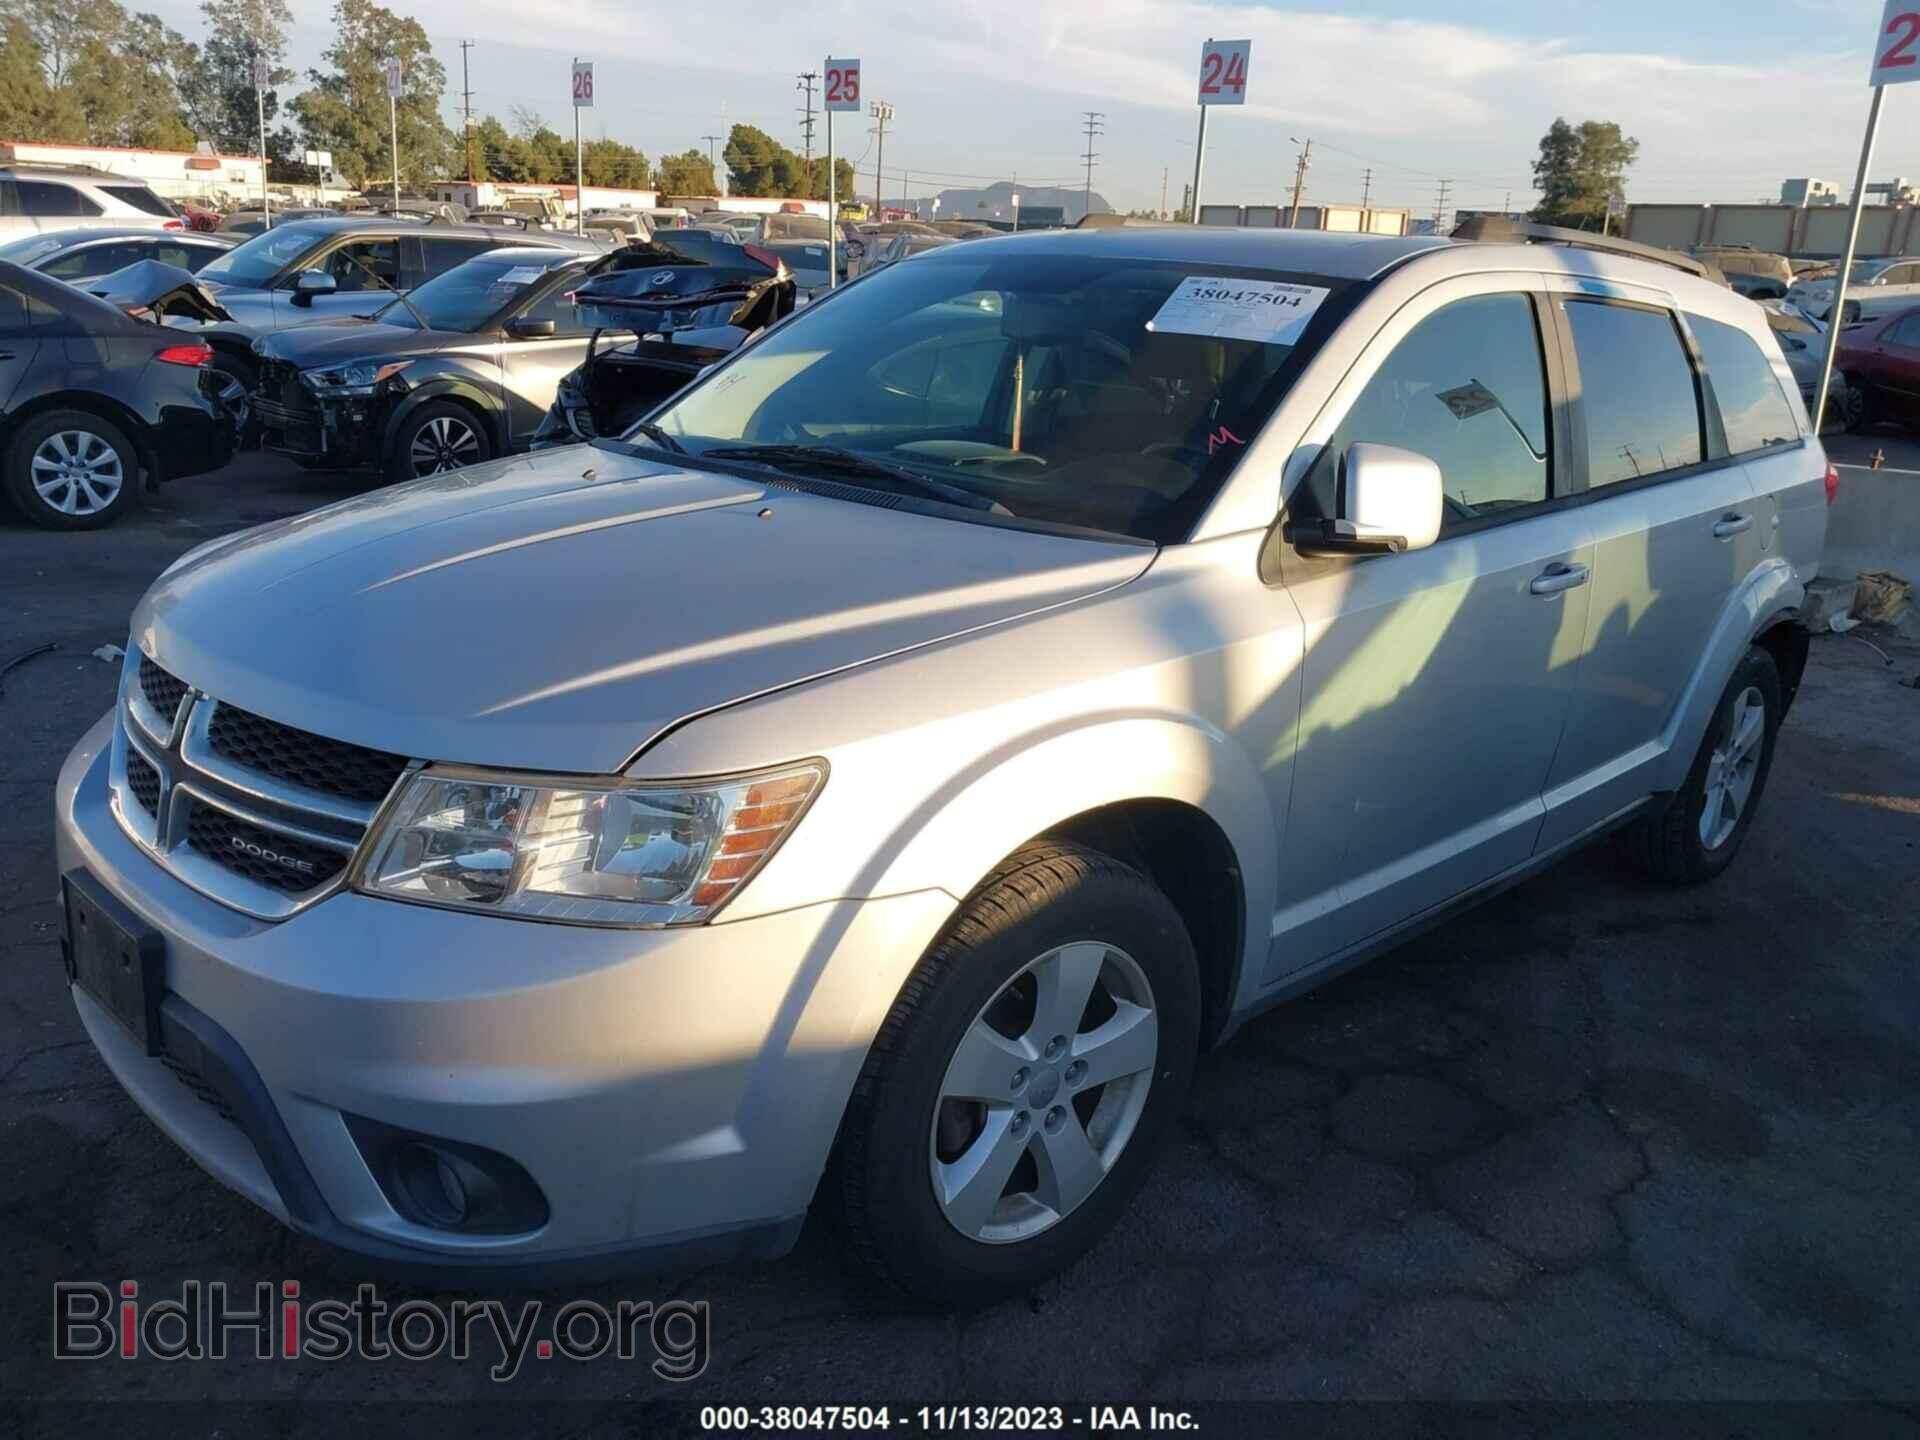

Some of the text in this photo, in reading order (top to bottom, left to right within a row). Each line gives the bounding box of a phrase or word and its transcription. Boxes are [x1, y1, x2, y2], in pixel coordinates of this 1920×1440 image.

[573, 71, 592, 98] 26
[826, 69, 859, 101] 25
[1200, 52, 1244, 94] 24
[1187, 287, 1302, 307] 38047504
[232, 837, 313, 873] DODGE
